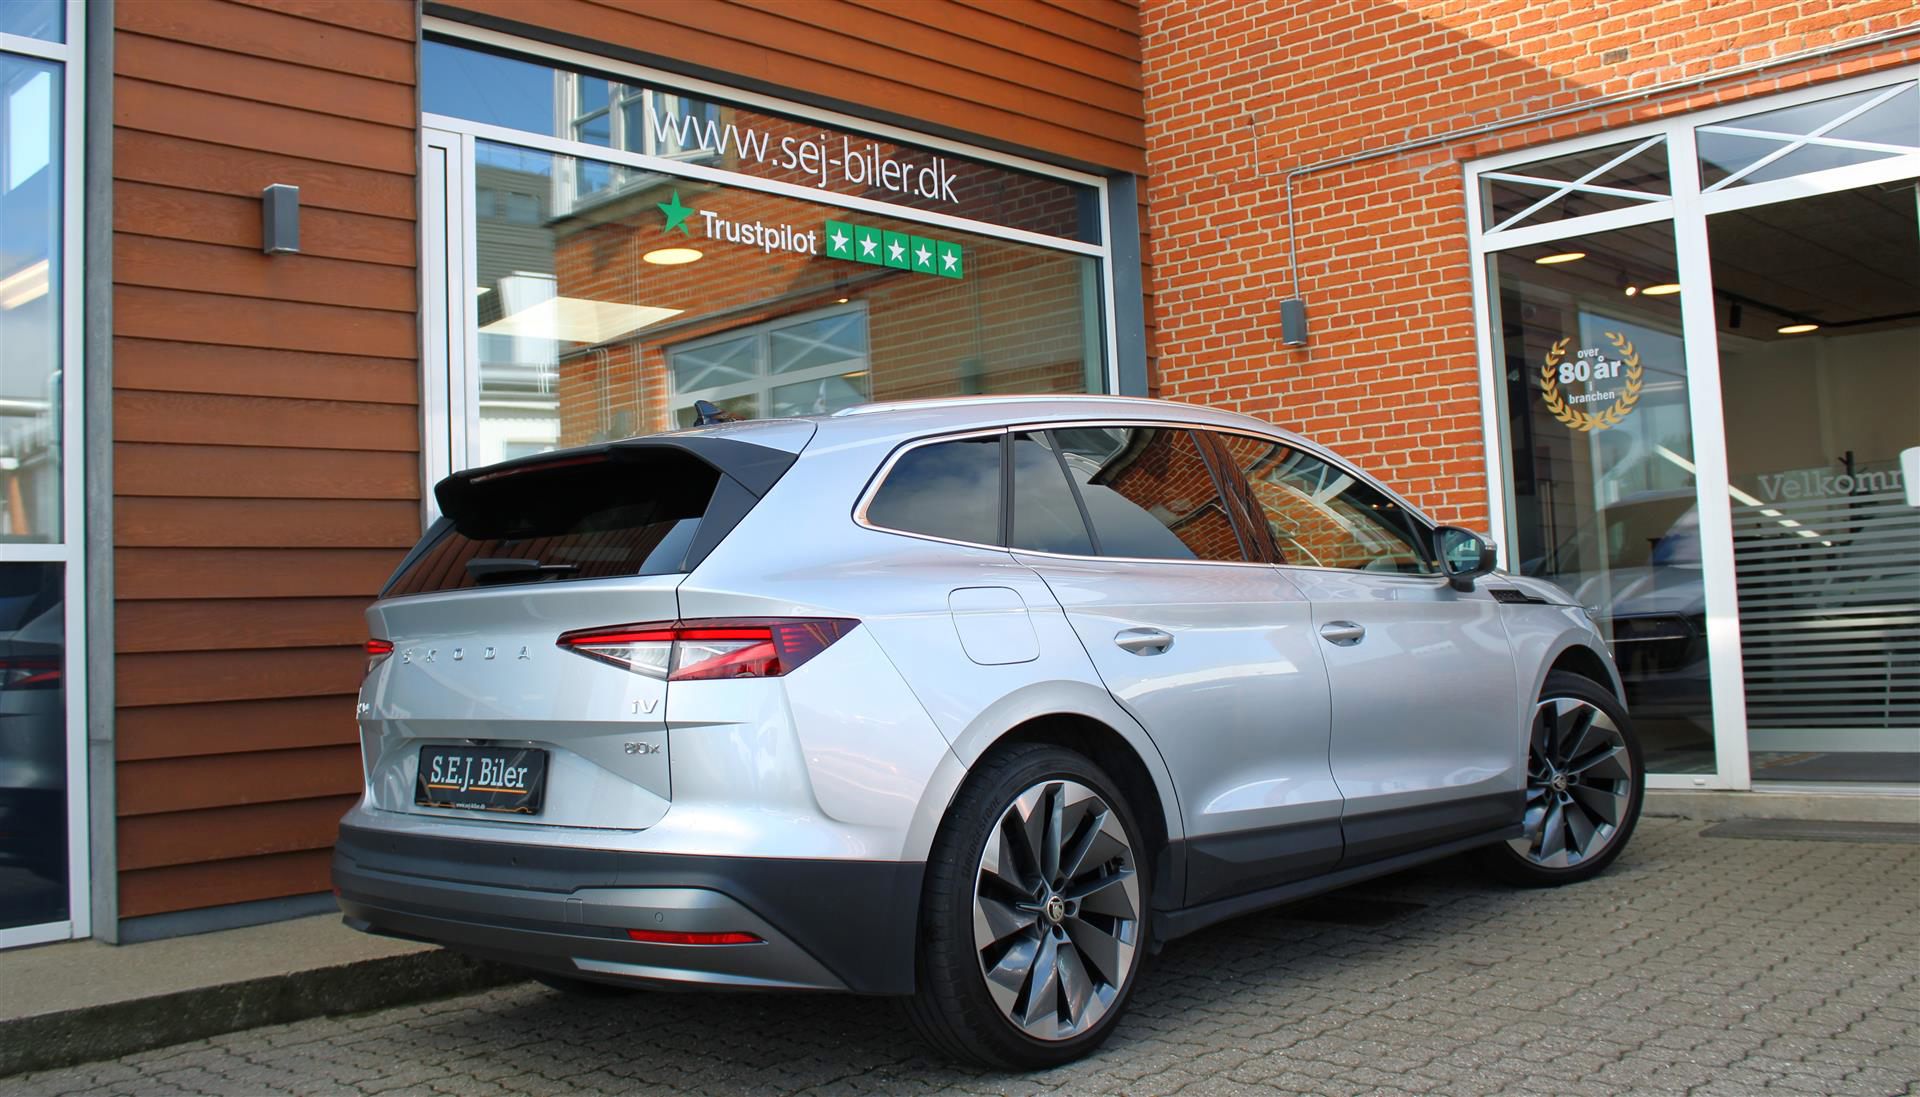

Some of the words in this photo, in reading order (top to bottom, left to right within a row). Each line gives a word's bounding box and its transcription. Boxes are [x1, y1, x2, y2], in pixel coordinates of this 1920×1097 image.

[649, 105, 959, 203] www.sej-biler.dk
[699, 209, 818, 255] Trustpilot
[1559, 361, 1590, 384] 80
[1594, 355, 1621, 379] år
[1577, 347, 1599, 359] over
[1569, 391, 1615, 404] branchen
[430, 755, 474, 792] S.E.J.
[478, 758, 528, 788] Biler
